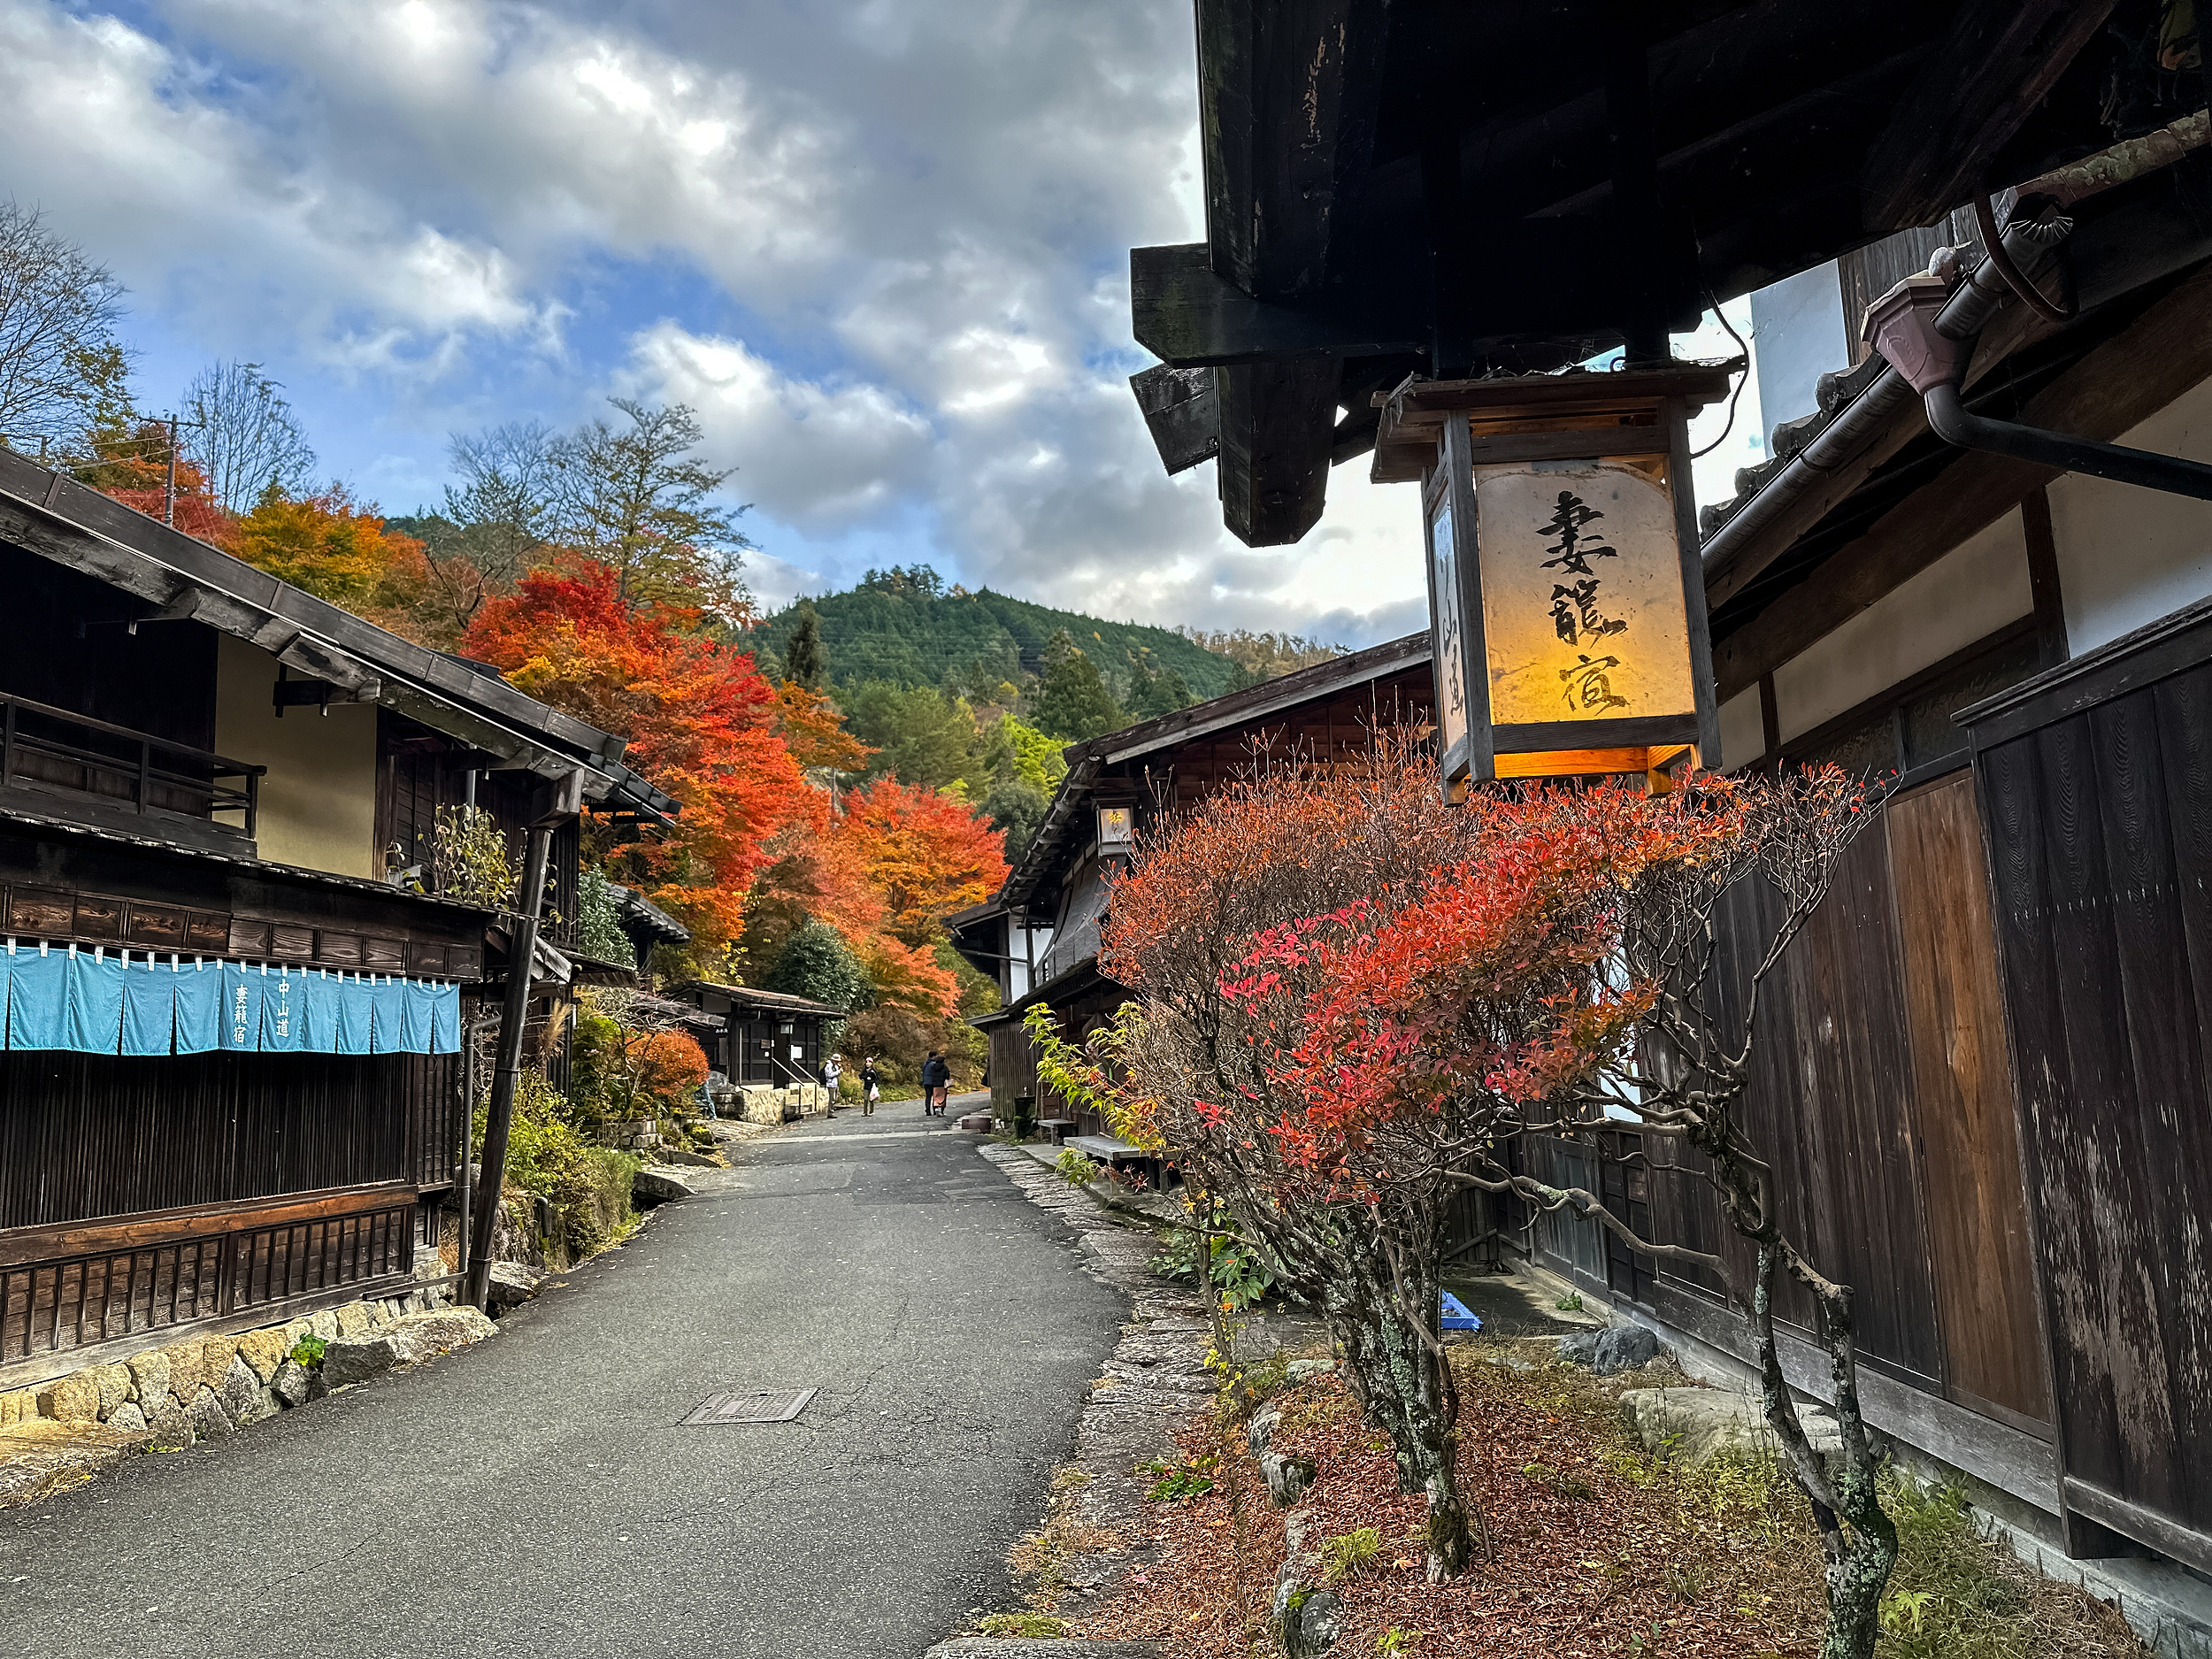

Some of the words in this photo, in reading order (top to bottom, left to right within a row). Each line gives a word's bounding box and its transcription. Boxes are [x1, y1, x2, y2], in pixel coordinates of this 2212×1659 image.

[1535, 489, 1631, 717] 妻籠宿
[233, 983, 248, 1044] 妻籠宿
[276, 978, 290, 1038] 中山道
